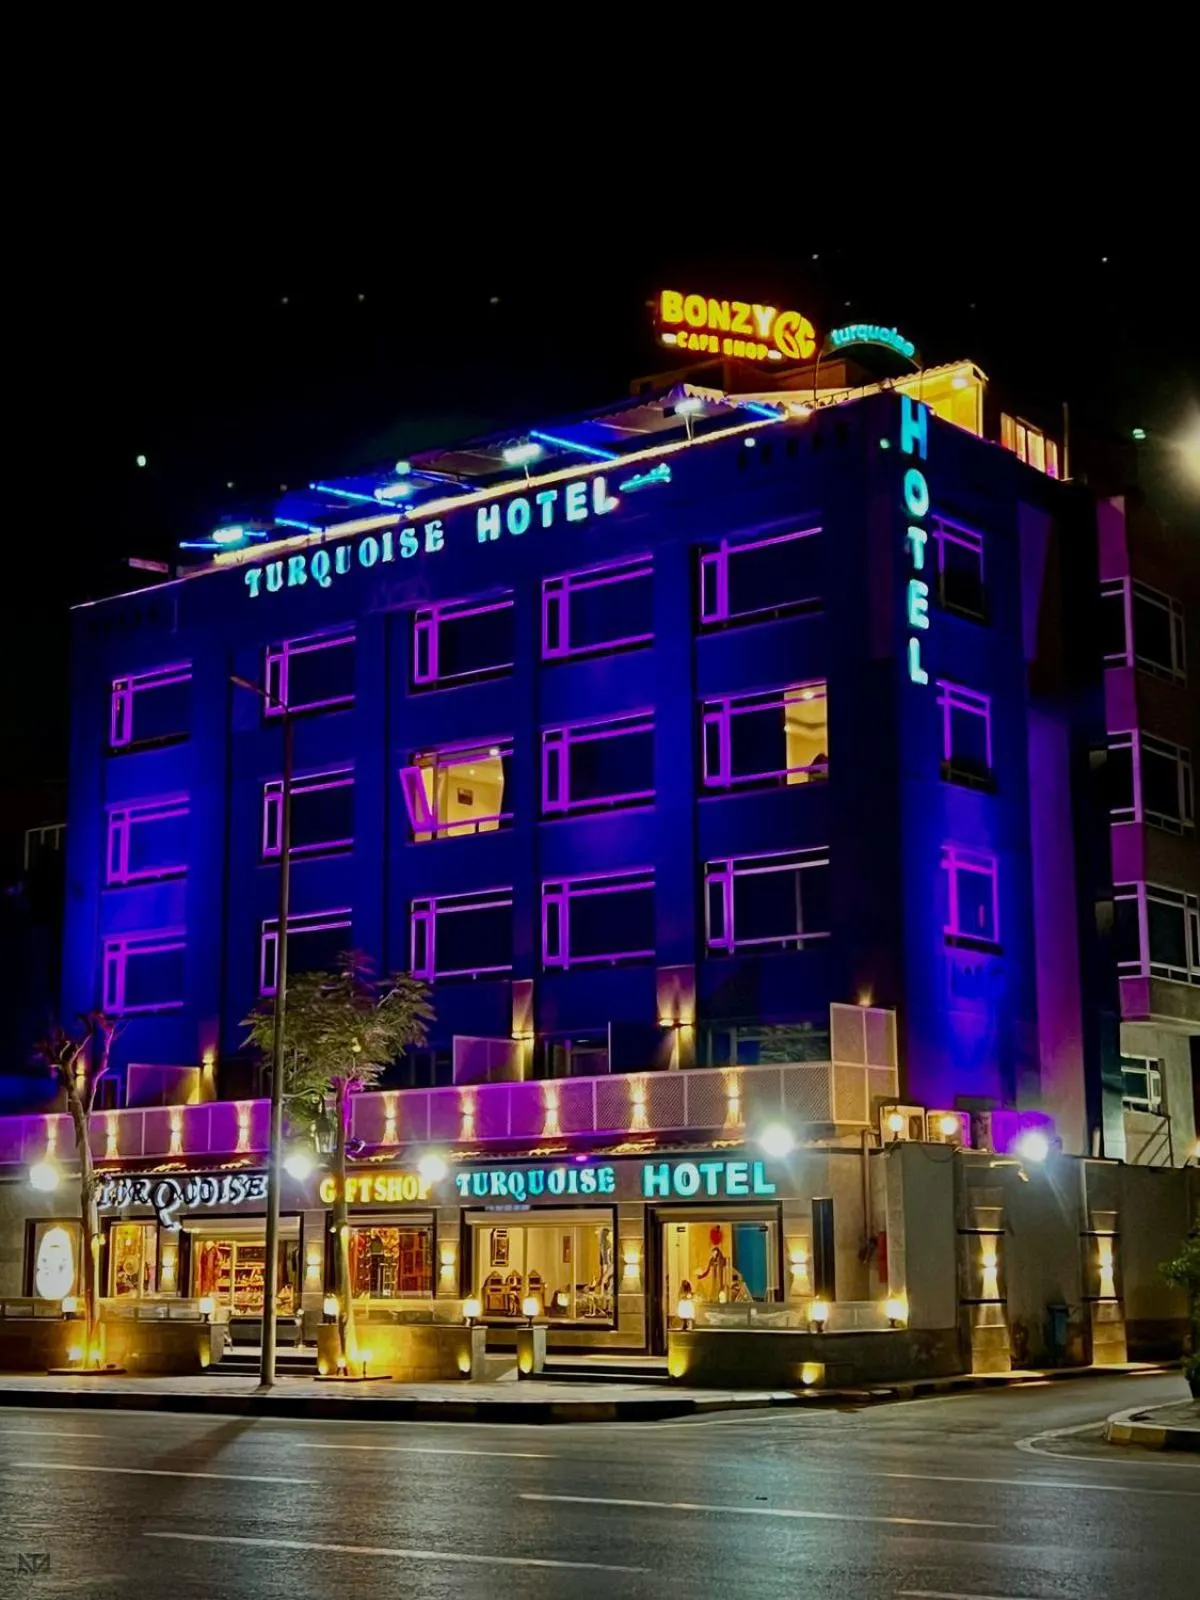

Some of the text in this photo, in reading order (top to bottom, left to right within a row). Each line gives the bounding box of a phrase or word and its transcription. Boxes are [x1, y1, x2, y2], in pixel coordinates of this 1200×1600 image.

[661, 290, 776, 338] BONZY
[677, 331, 768, 361] CAFE SHOP
[244, 520, 445, 598] TURQUOISE
[476, 476, 620, 543] HOTEL
[900, 394, 930, 685] HOTEL
[320, 1177, 373, 1203] GFT
[456, 1160, 776, 1201] TURQUOISE HOTEL
